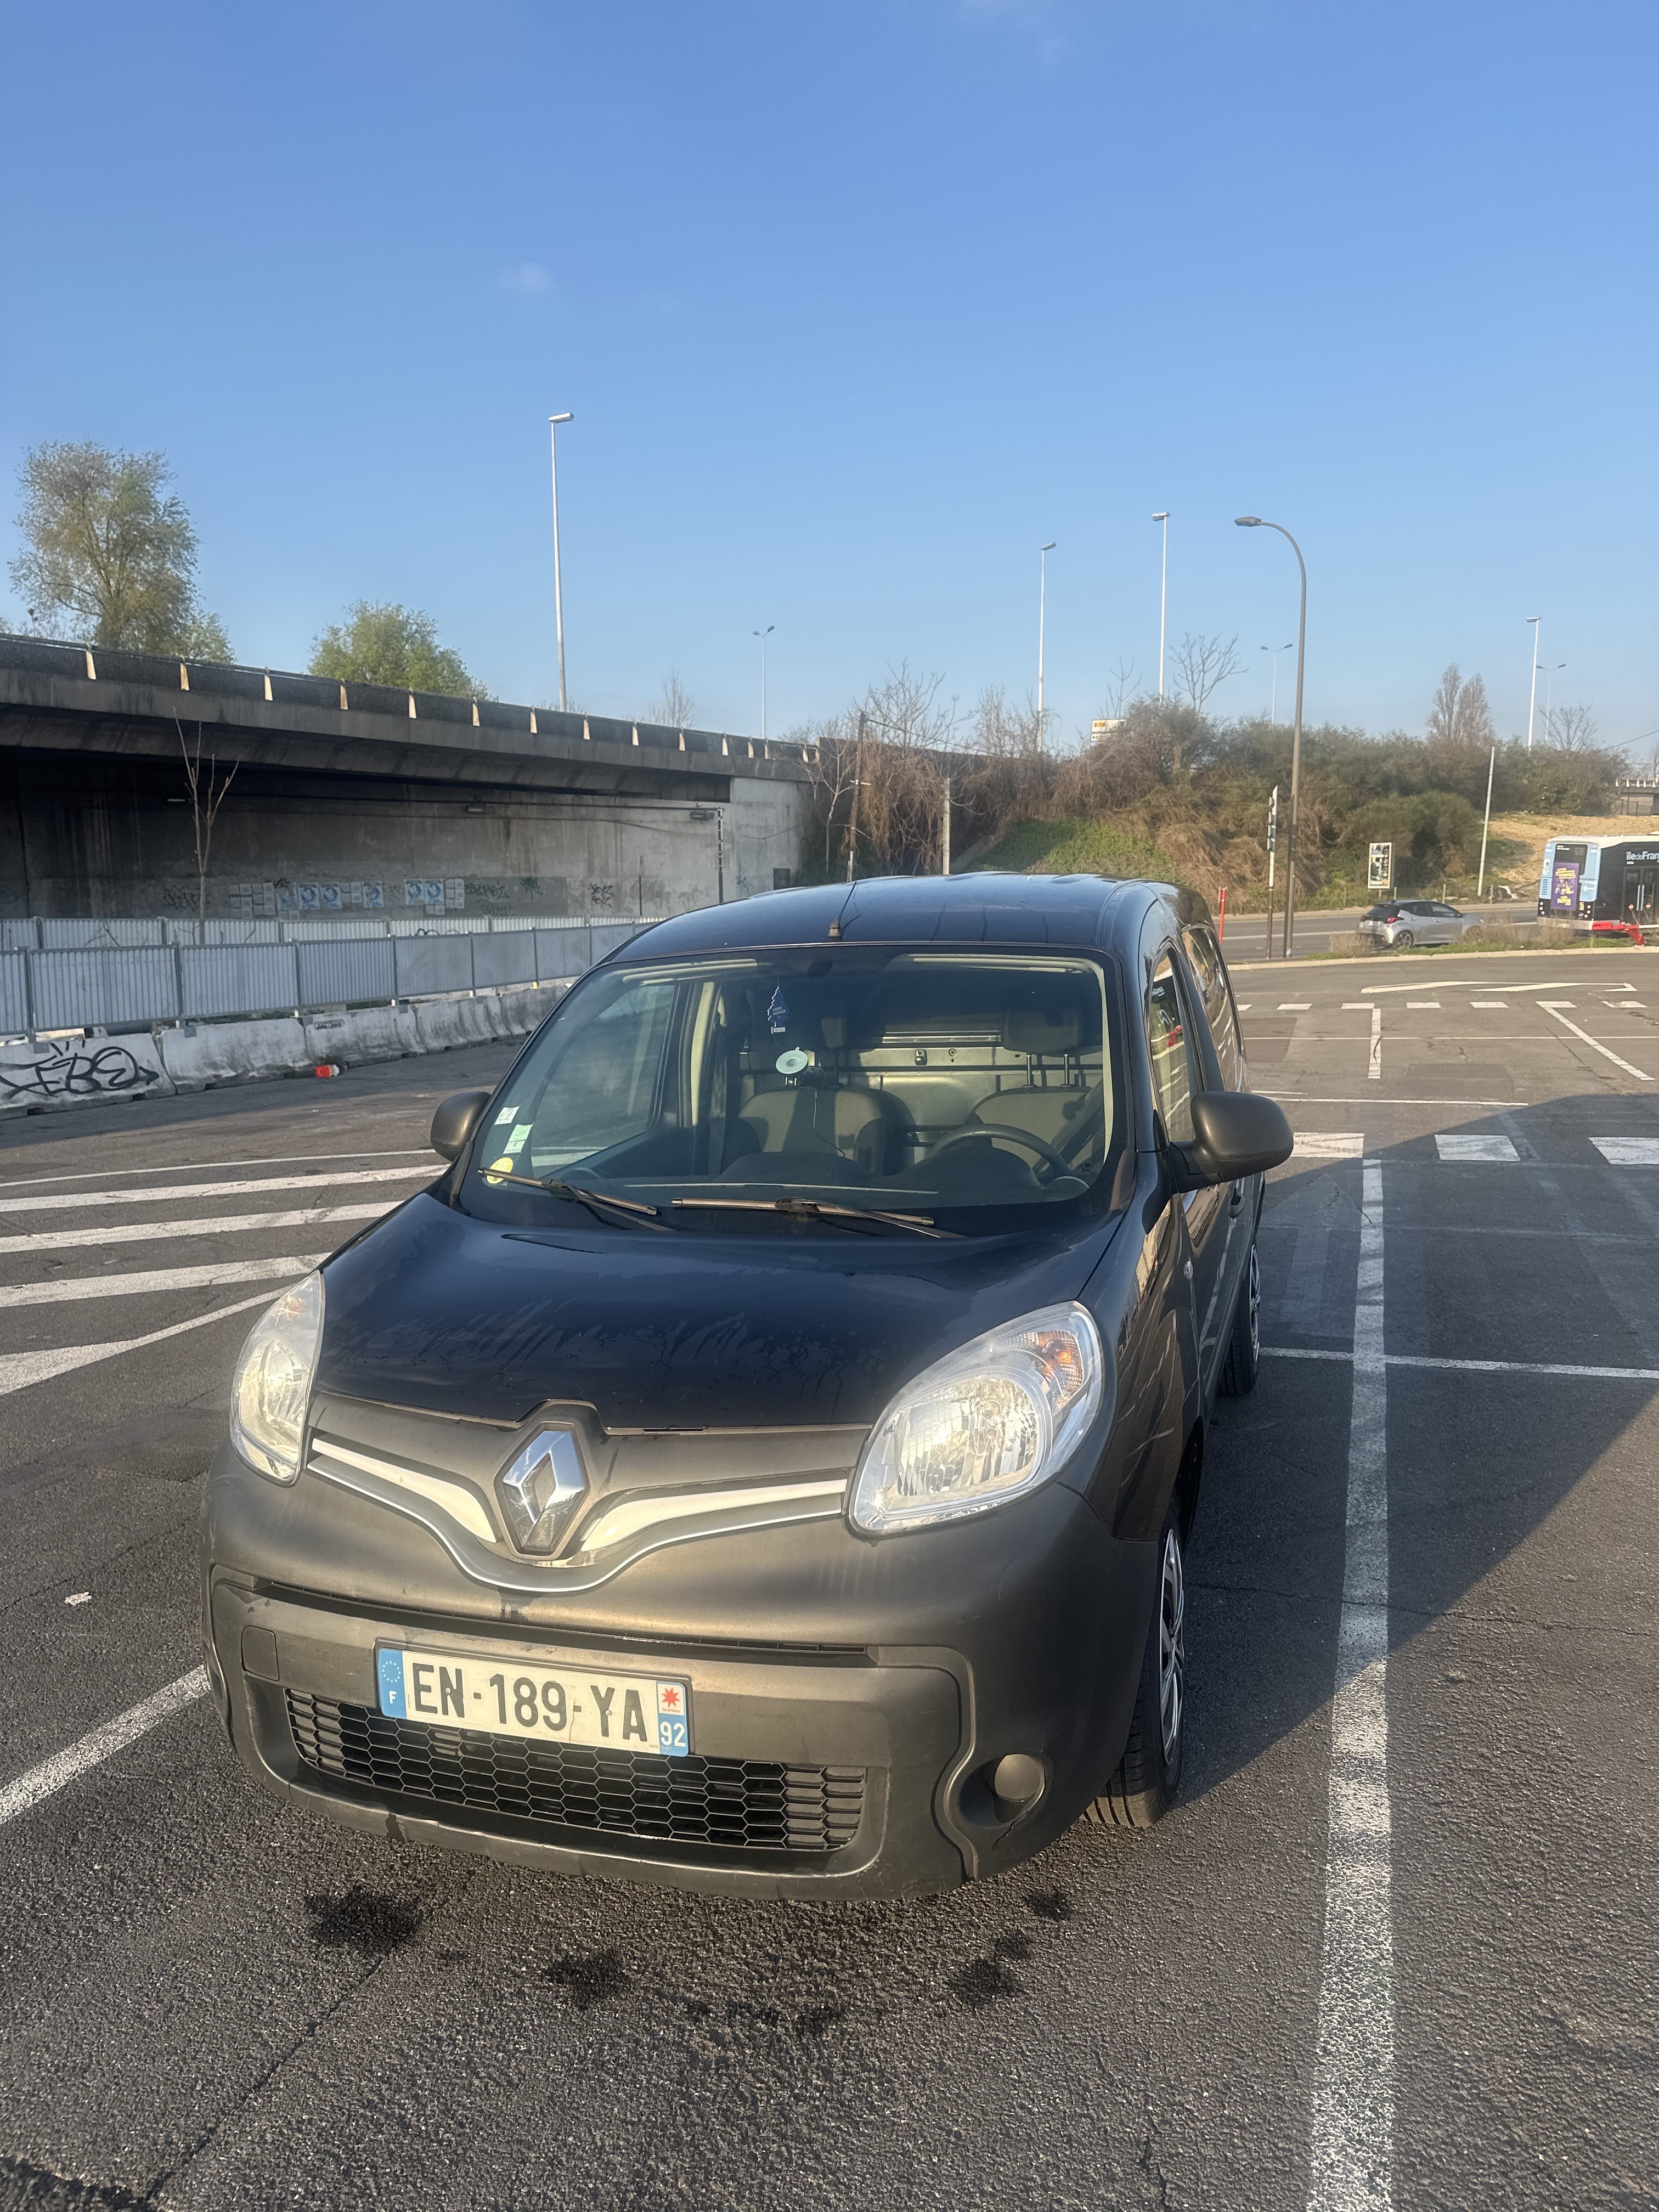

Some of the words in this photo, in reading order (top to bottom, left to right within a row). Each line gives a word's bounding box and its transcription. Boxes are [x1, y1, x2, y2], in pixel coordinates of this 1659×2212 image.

[389, 1691, 397, 1704] F
[413, 1663, 647, 1742] EN-189-YA
[660, 1721, 686, 1747] 92
